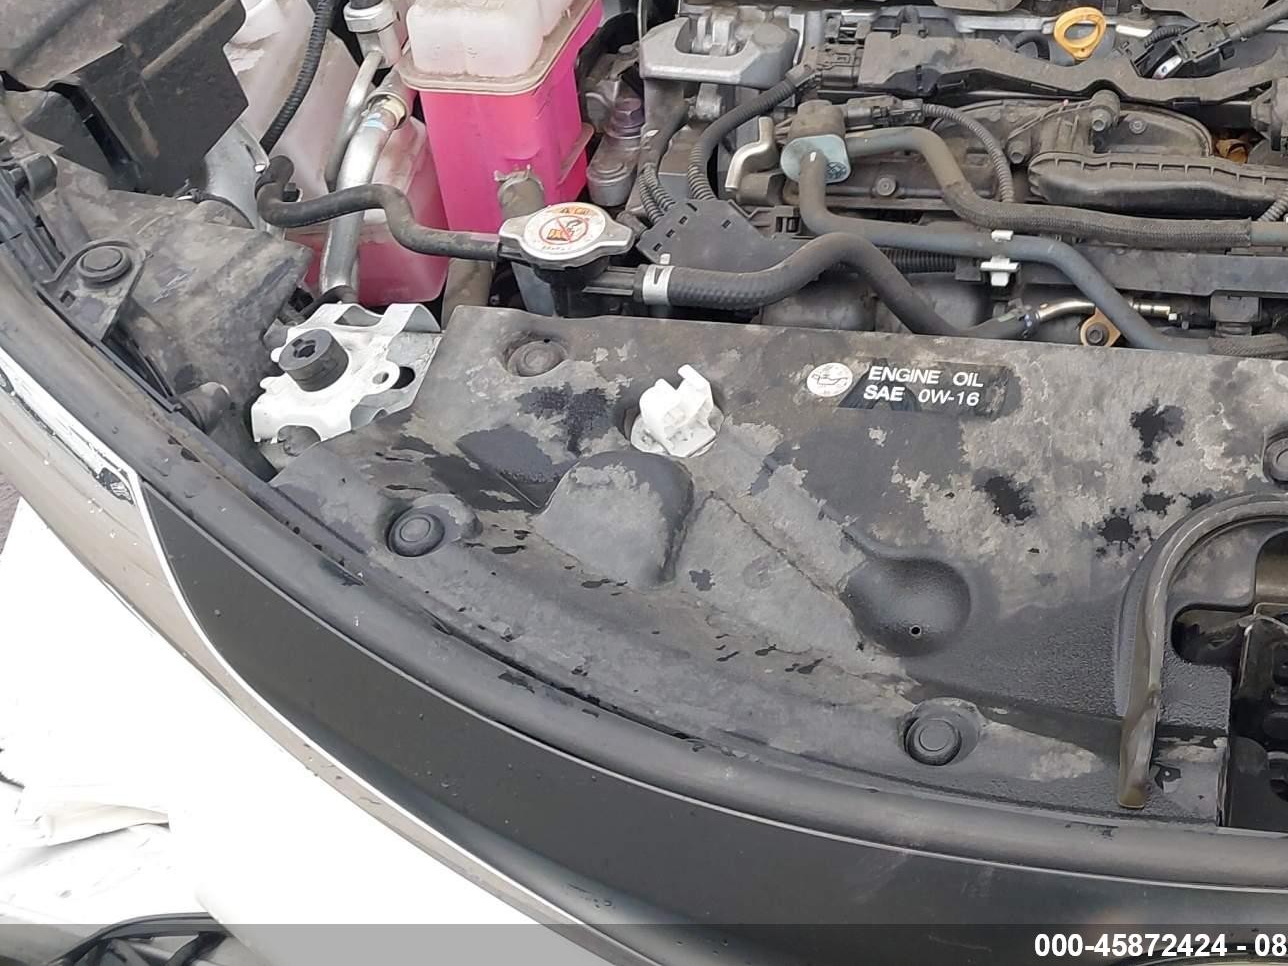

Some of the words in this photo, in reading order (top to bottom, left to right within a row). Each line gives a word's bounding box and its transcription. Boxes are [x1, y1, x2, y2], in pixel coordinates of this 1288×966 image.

[868, 365, 942, 385] ENGINE
[953, 371, 984, 388] OIL
[863, 384, 905, 402] SAE
[918, 388, 980, 407] 0W-16
